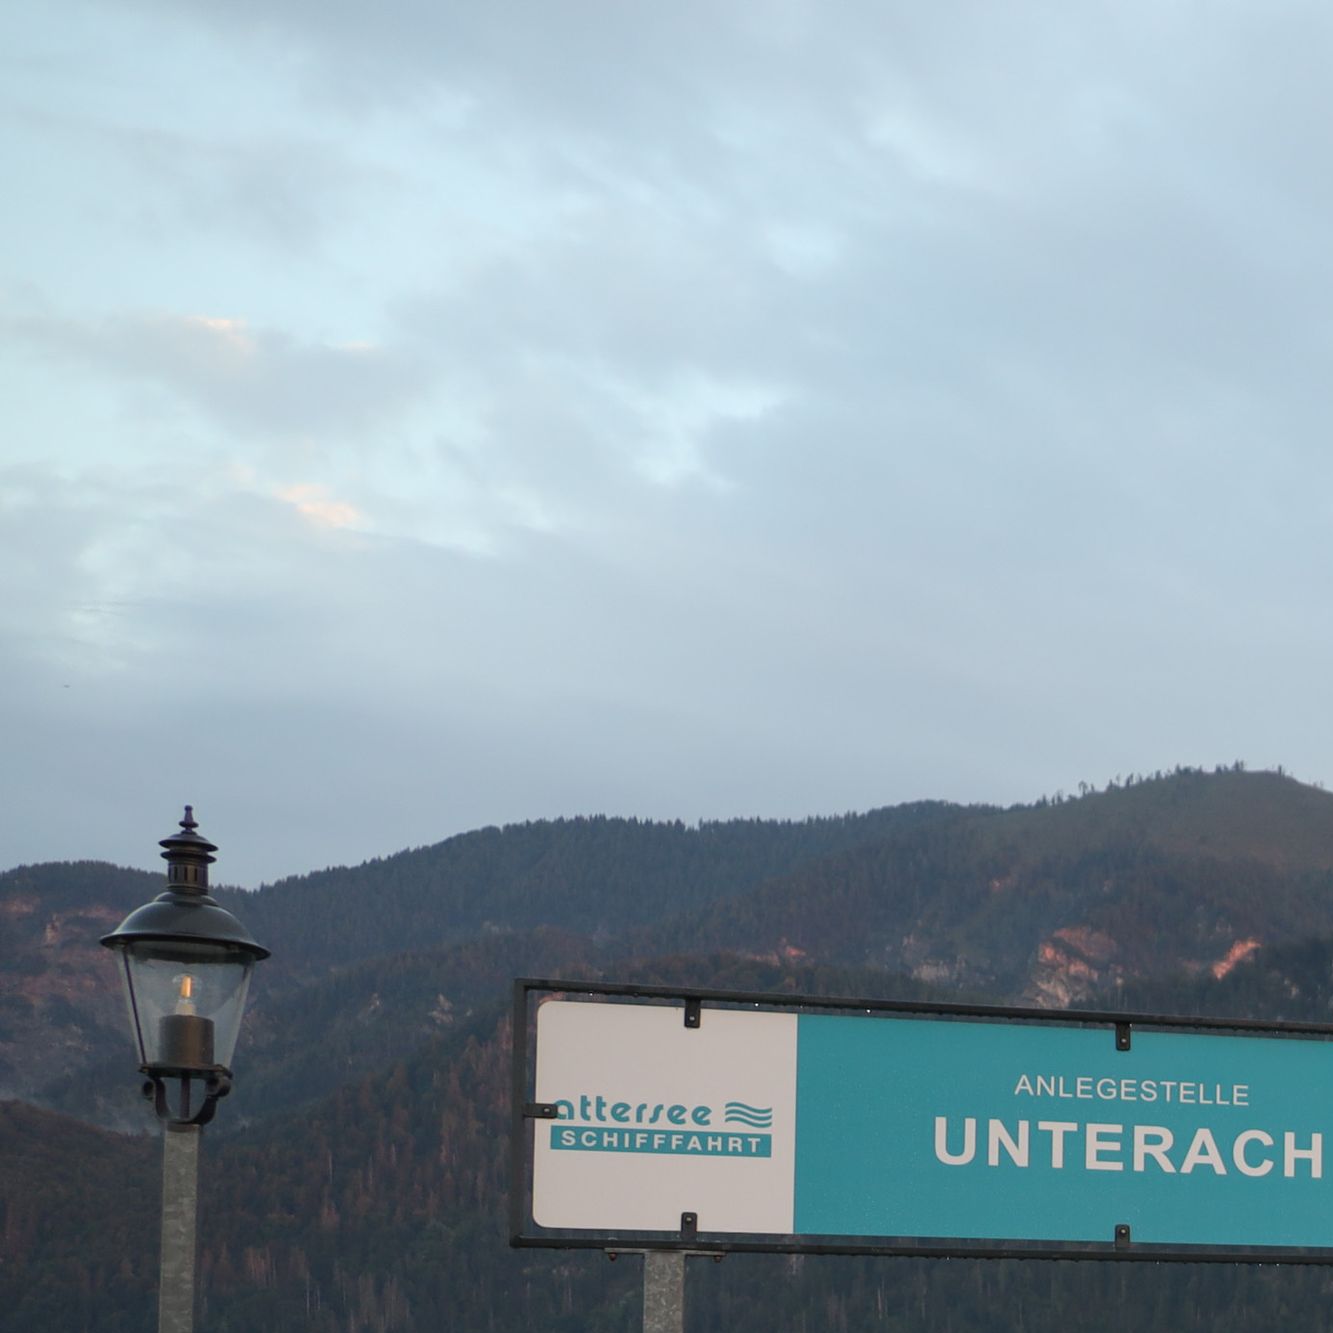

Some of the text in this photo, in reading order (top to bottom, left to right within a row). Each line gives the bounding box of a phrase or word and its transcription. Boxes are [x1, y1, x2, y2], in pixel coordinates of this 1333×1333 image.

[1014, 1074, 1249, 1106] ANLEGESTELLE
[555, 1095, 712, 1126] attersee
[561, 1130, 761, 1153] SCHIFFFAHRT
[934, 1116, 1323, 1179] UNTERACH
